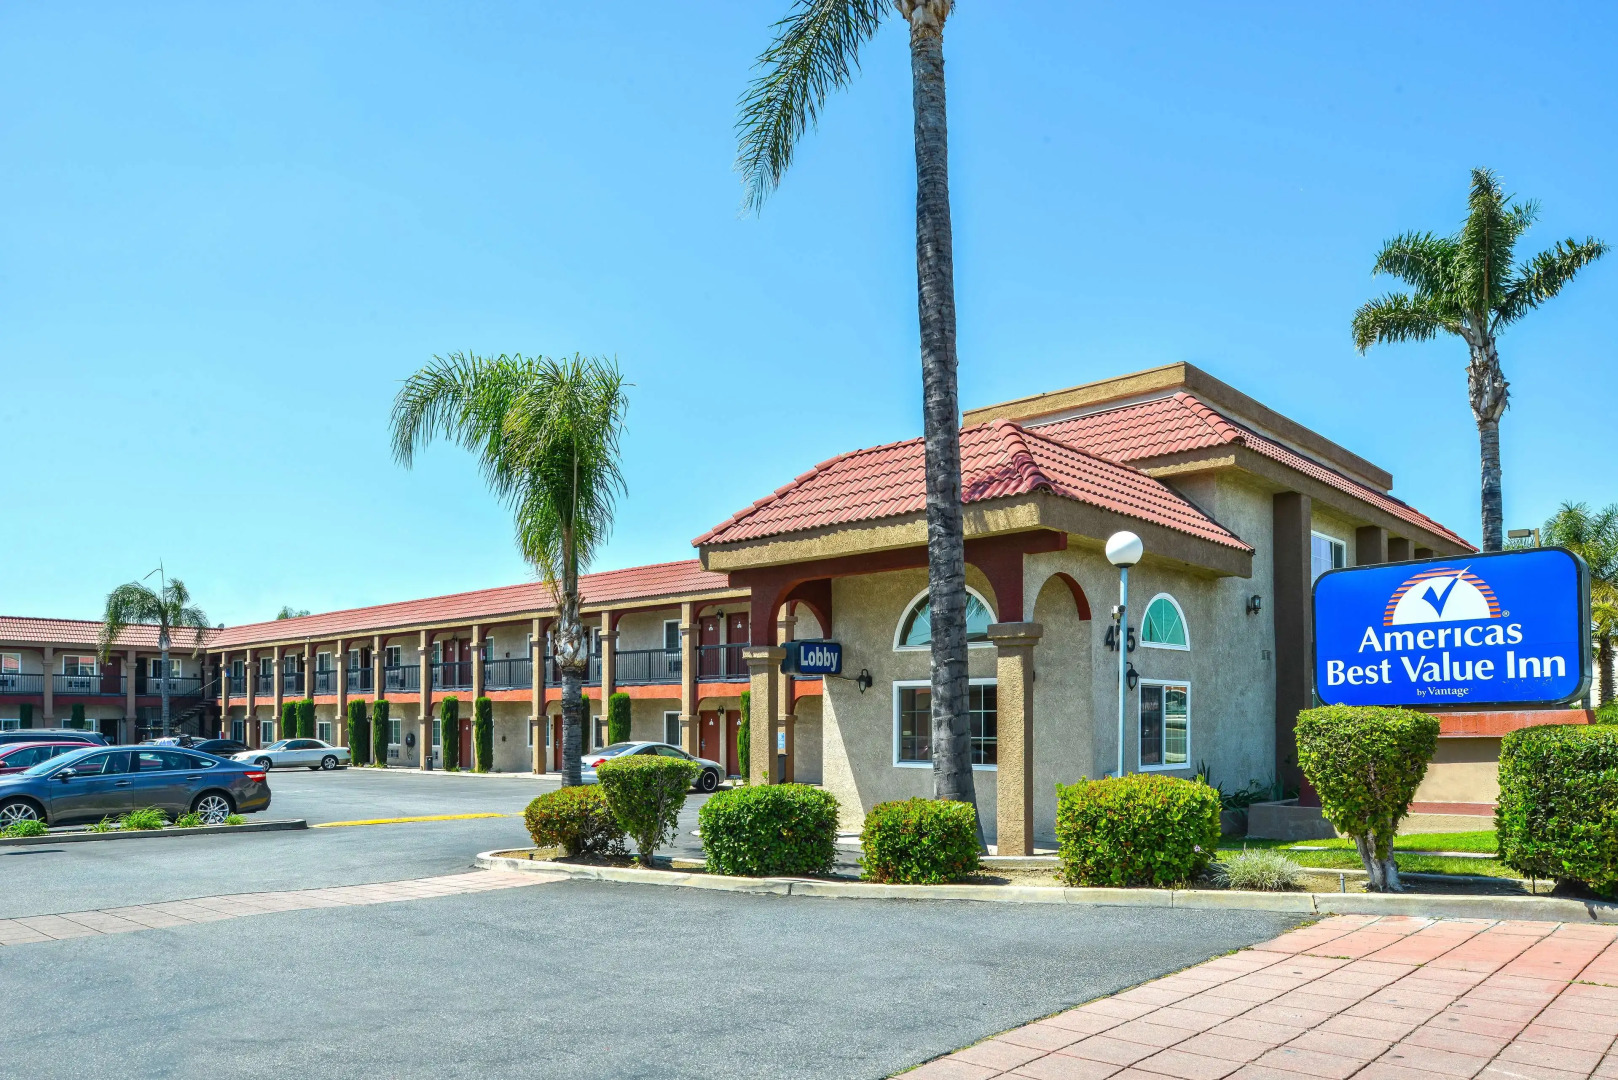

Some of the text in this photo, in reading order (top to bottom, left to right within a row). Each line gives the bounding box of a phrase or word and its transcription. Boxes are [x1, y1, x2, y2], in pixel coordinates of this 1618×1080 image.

[1358, 623, 1522, 652] Americas
[800, 645, 838, 672] Lobby
[1327, 650, 1566, 686] Best Value Inn
[1416, 686, 1469, 697] by Vantage
